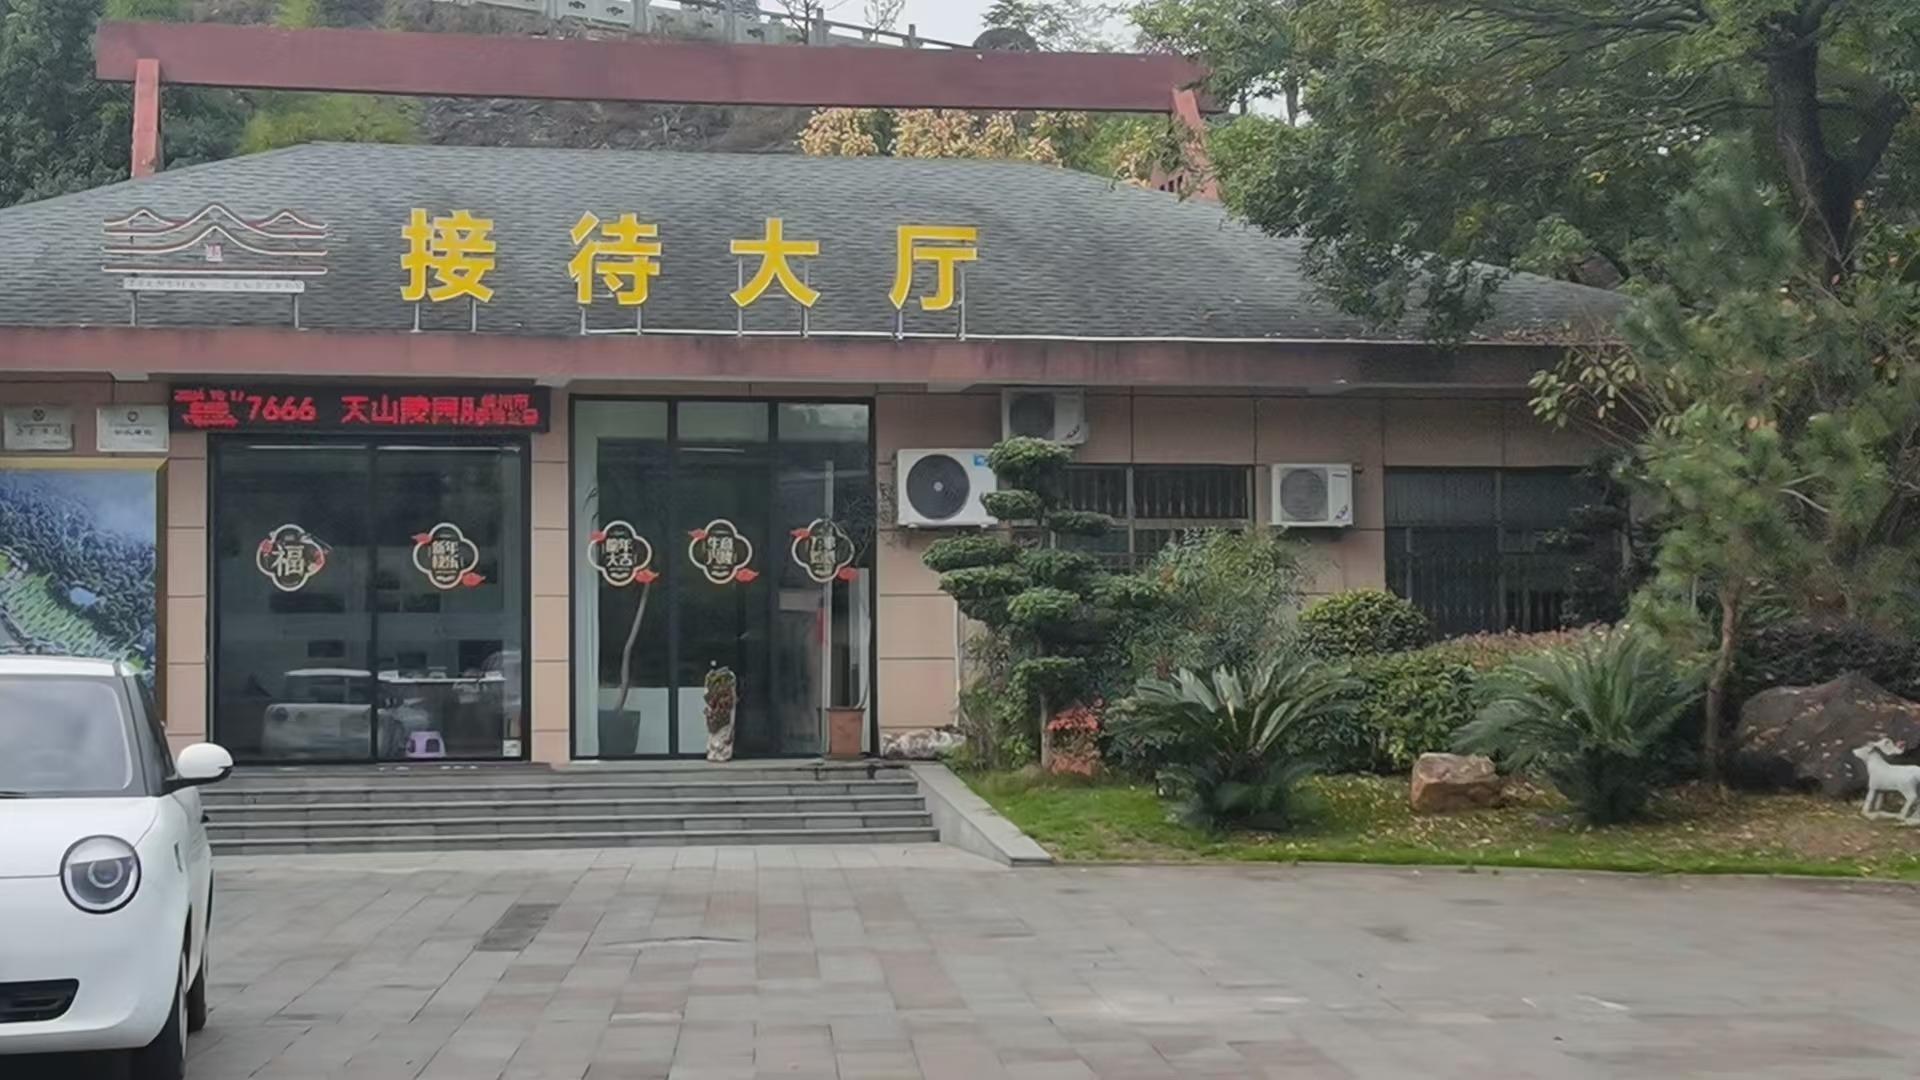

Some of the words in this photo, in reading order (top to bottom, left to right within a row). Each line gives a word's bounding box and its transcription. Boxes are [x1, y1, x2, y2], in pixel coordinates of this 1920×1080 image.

[400, 208, 979, 311] 接待大厅
[247, 395, 317, 421] 7666
[272, 544, 305, 576] 福
